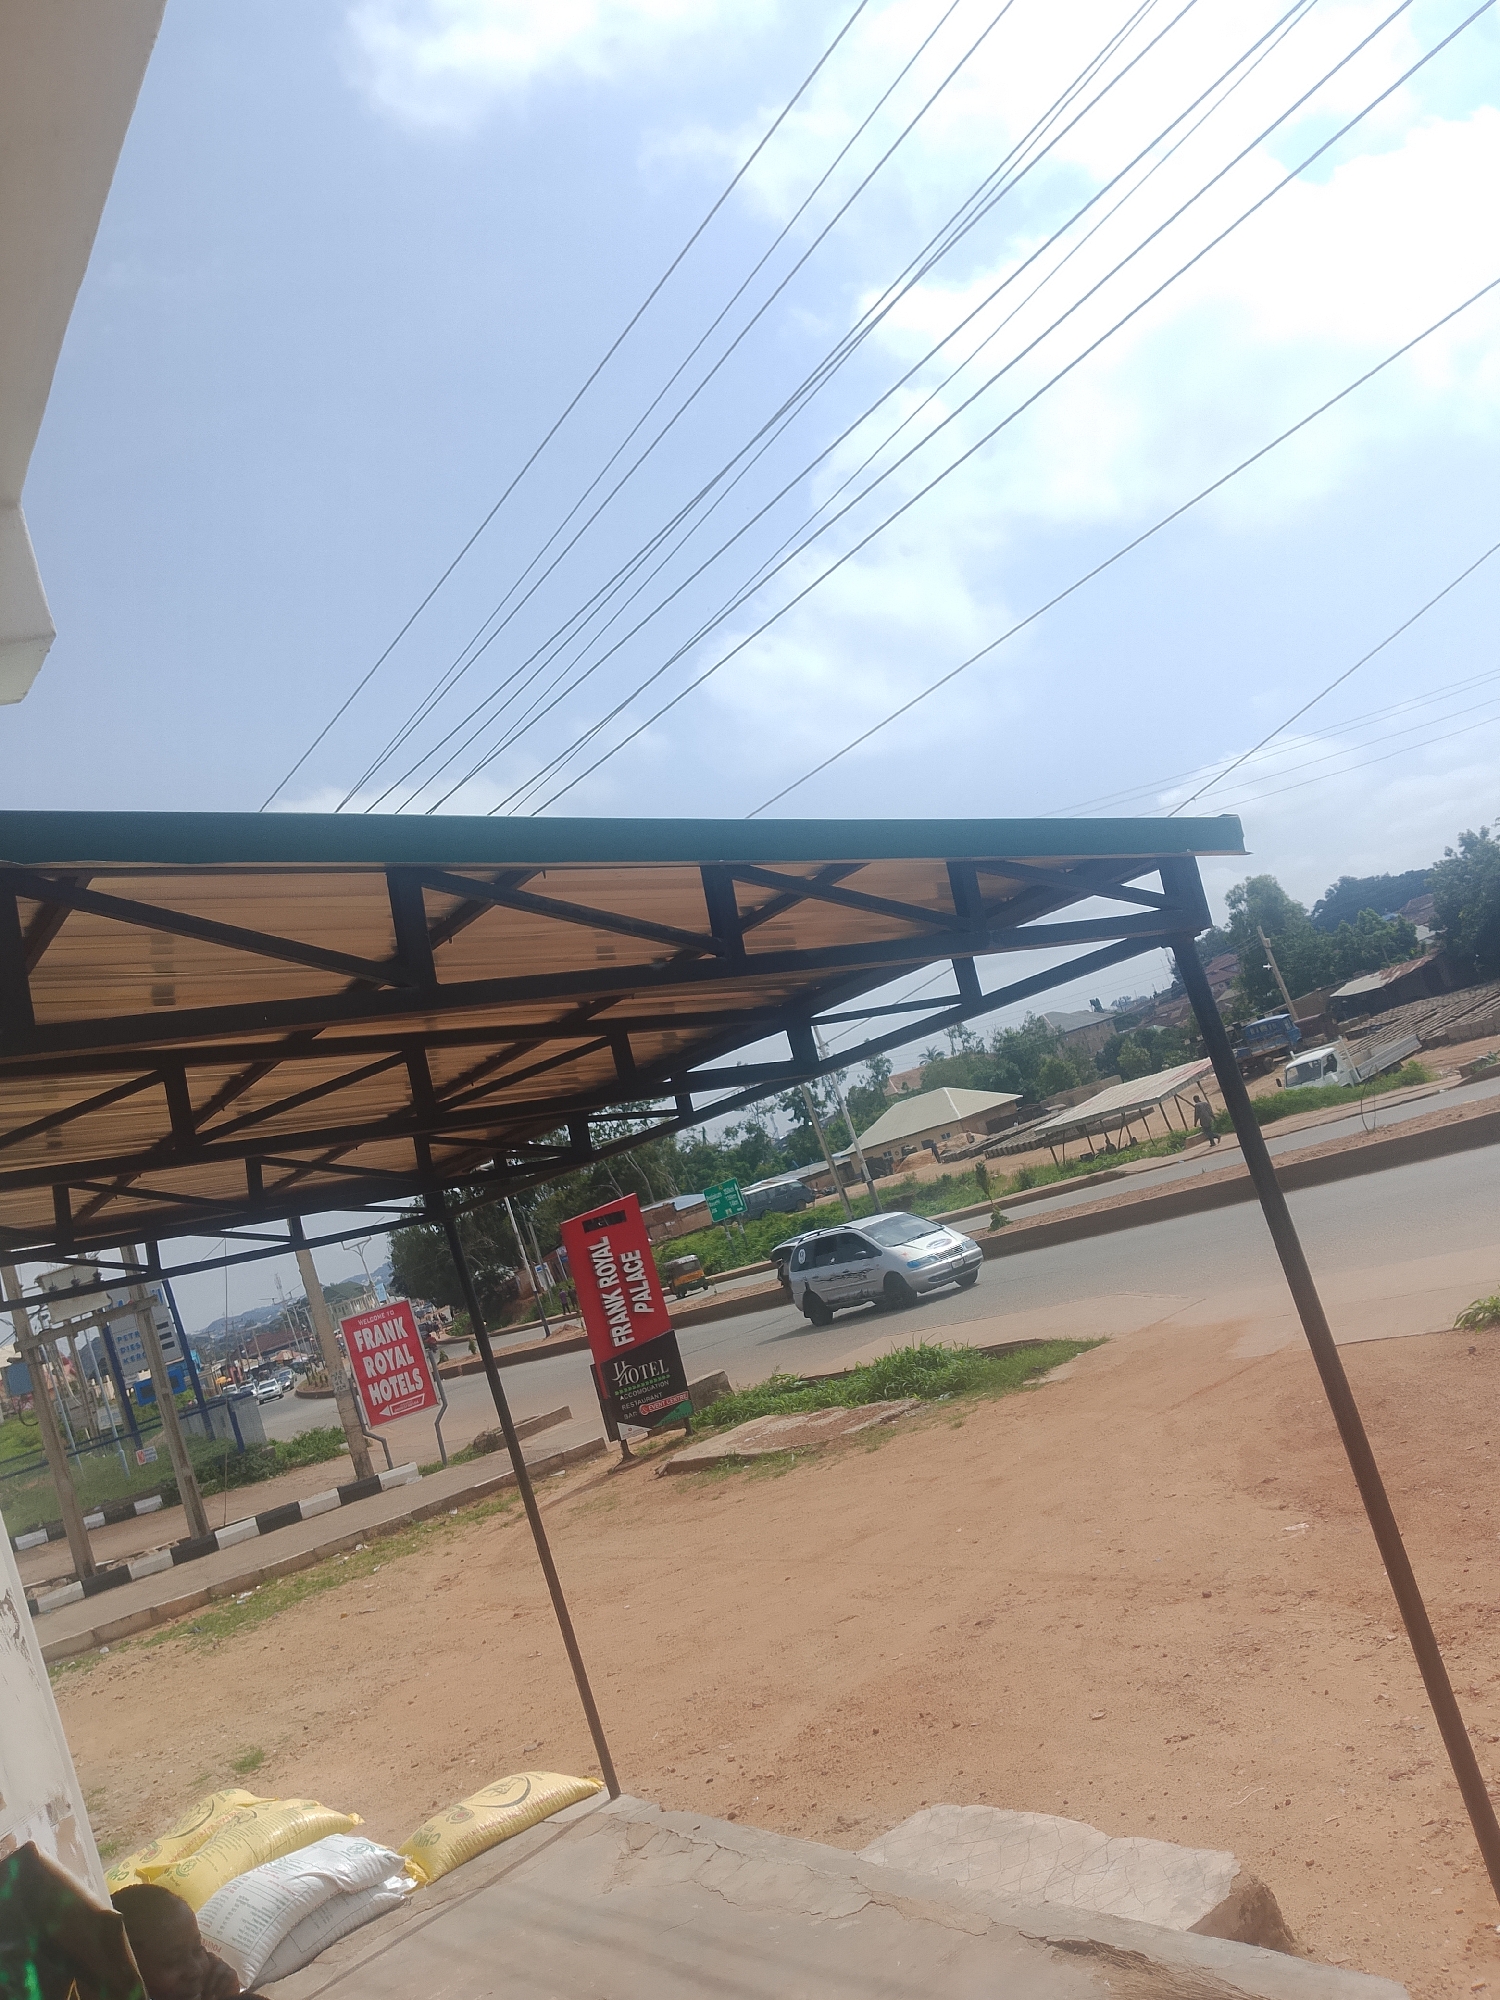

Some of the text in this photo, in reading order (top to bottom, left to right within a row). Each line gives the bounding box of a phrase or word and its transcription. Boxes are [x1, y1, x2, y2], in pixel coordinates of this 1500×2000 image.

[588, 1236, 635, 1347] FRANK ROYAL
[620, 1249, 655, 1313] PALACE
[358, 1312, 386, 1326] WELCOME
[116, 1331, 140, 1343] PETR
[120, 1342, 141, 1355] DIES
[353, 1316, 408, 1353] FRANK
[362, 1343, 415, 1378] ROYAL
[612, 1359, 669, 1387] HOTEL
[368, 1368, 424, 1406] HOTELS
[621, 1392, 663, 1410] RESTAURANT
[648, 1399, 666, 1411] EVENT
